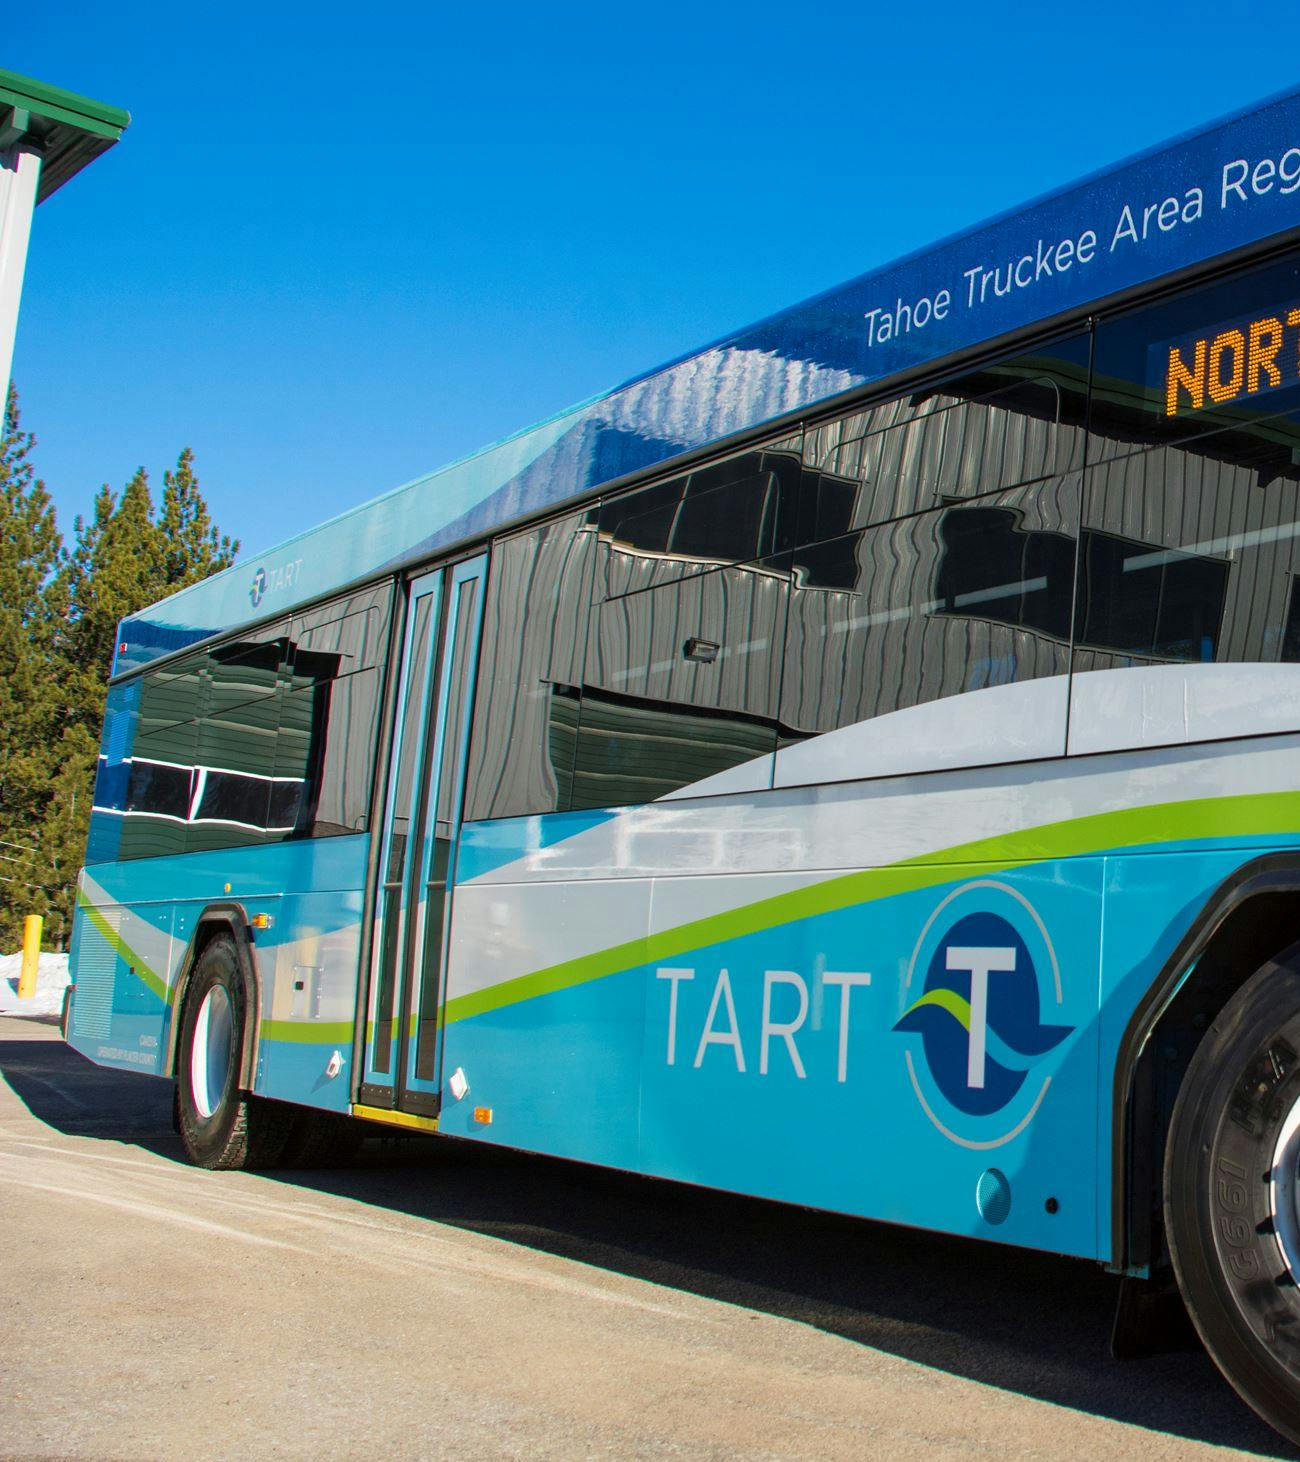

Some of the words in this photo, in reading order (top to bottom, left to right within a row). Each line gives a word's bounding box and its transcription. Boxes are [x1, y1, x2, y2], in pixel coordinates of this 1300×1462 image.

[864, 288, 950, 347] Tahoe
[963, 230, 1097, 308] Truckee
[1110, 187, 1203, 252] Area
[269, 559, 303, 592] TART
[656, 967, 871, 1083] TART
[946, 947, 1016, 1089] T
[1217, 1157, 1260, 1281] G661
